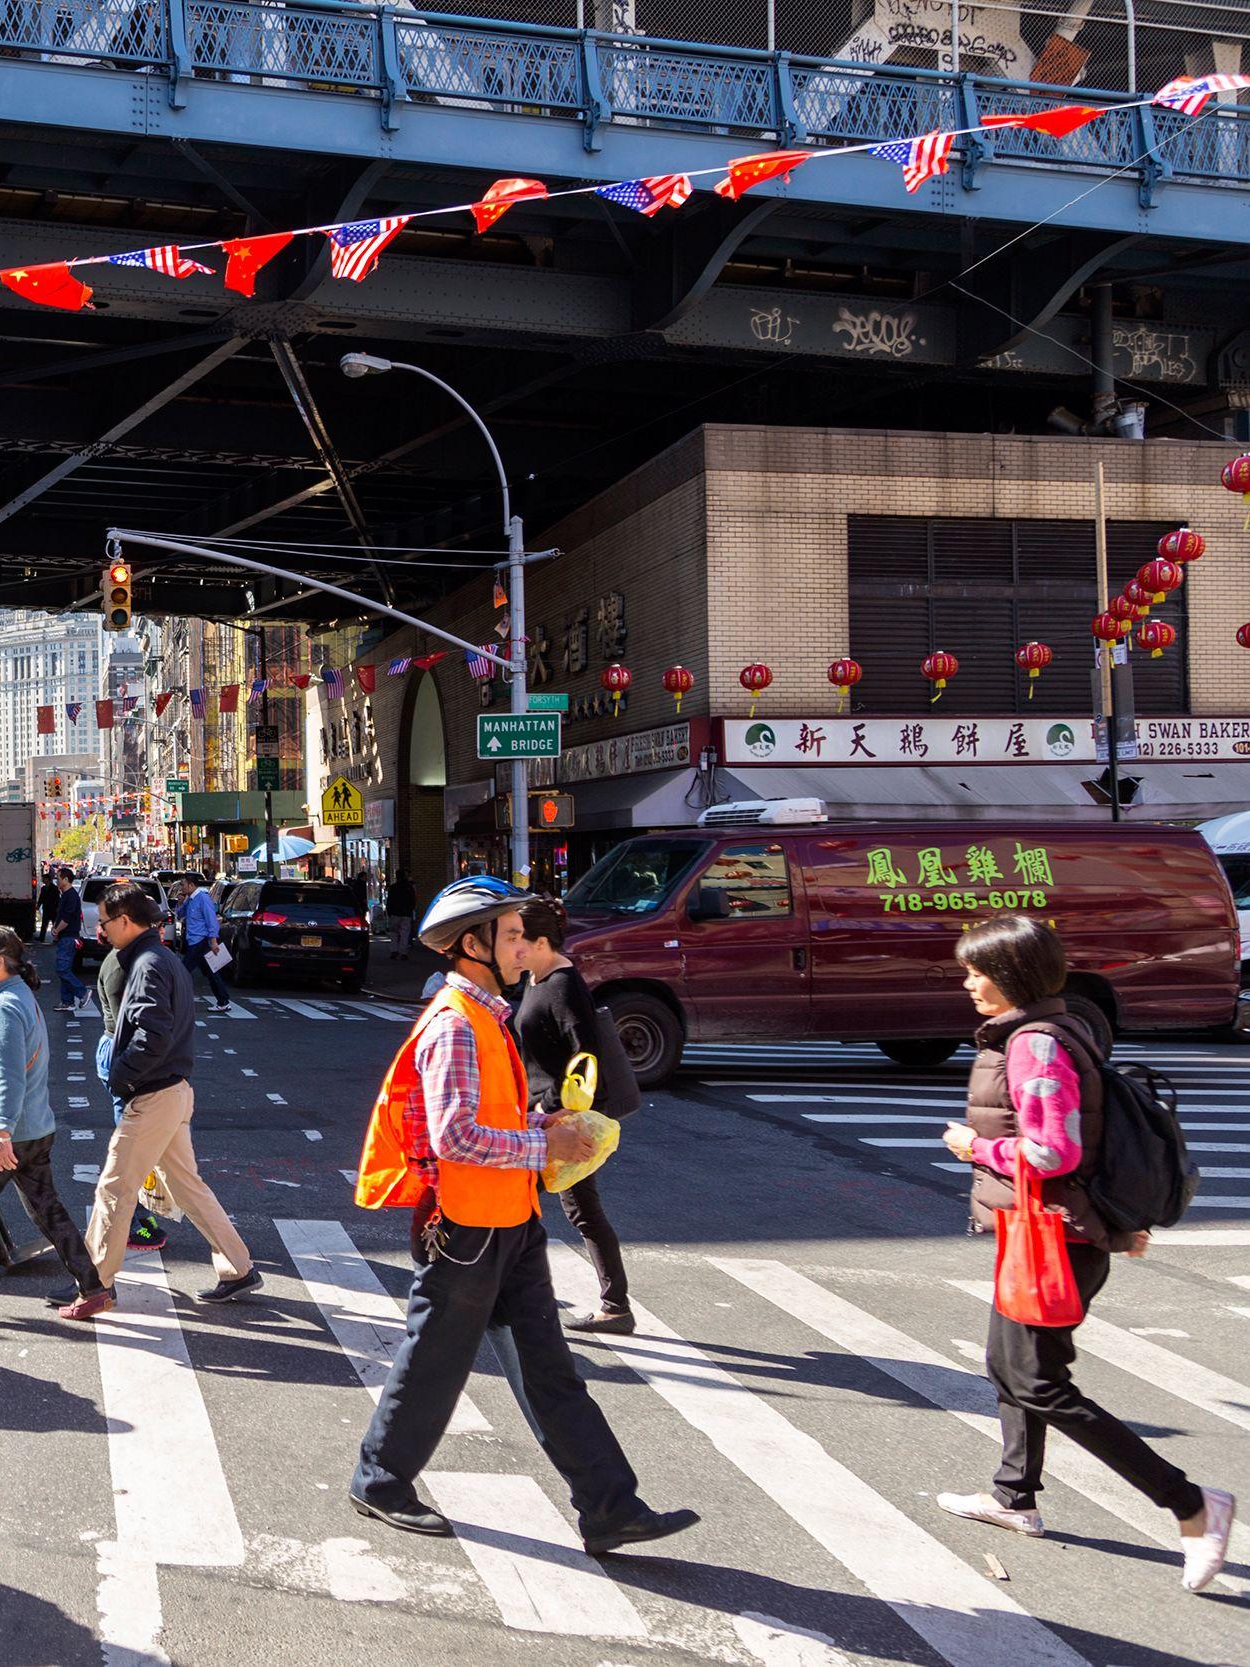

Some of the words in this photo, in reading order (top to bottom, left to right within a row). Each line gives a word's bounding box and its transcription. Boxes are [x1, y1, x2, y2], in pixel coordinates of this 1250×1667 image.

[529, 695, 560, 704] FORSYTH
[484, 720, 555, 733] MANHATTAN
[1148, 722, 1191, 739] SWAN
[511, 739, 553, 751] BRIDGE
[794, 722, 1030, 758] 新天鵝餅屋
[327, 812, 359, 822] AHEAD
[866, 842, 1054, 889] 鳳凰雞欄
[879, 890, 1047, 912] 718-965-6078
